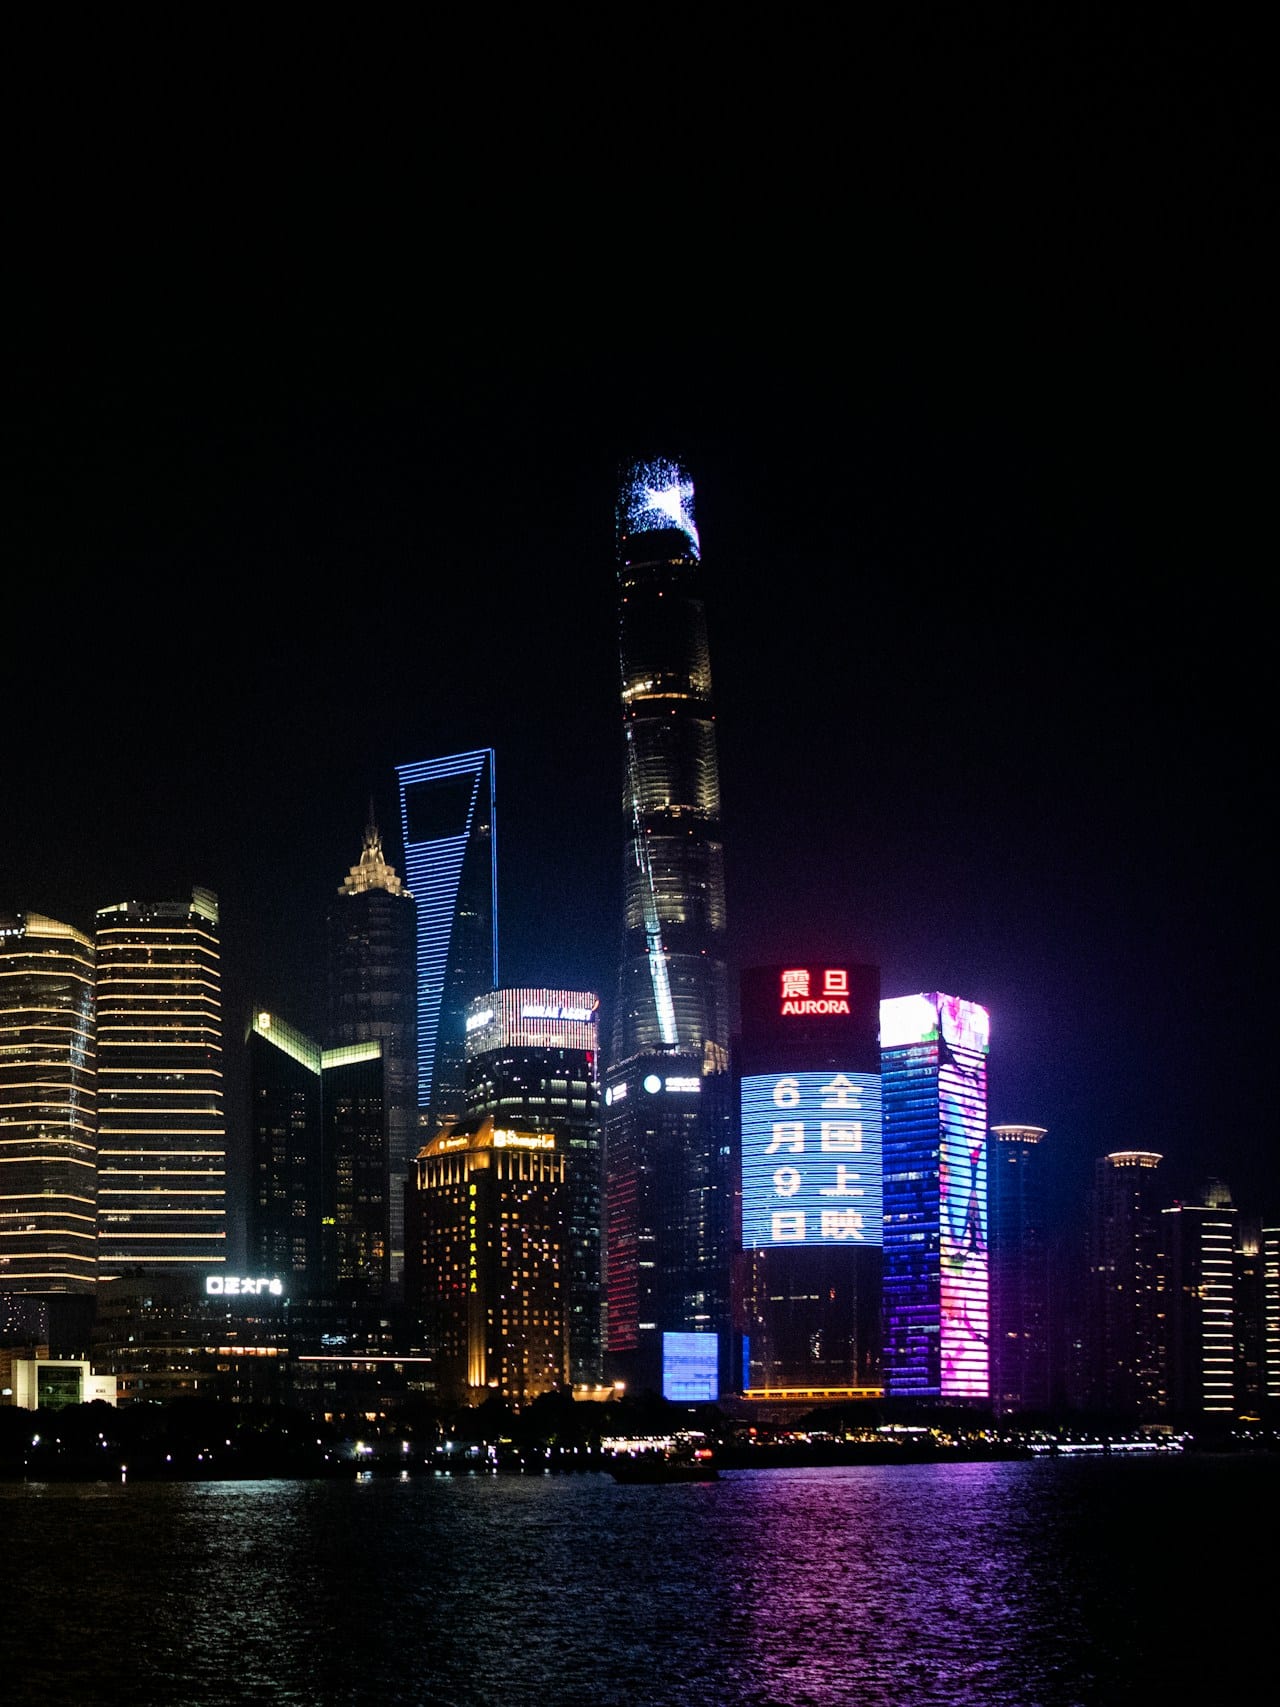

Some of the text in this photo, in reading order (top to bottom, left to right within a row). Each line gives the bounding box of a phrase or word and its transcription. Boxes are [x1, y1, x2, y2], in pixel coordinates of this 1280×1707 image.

[781, 969, 850, 998] 震旦
[781, 999, 850, 1015] AURORA
[763, 1077, 806, 1241] 6月9日
[818, 1074, 865, 1240] 全国上映
